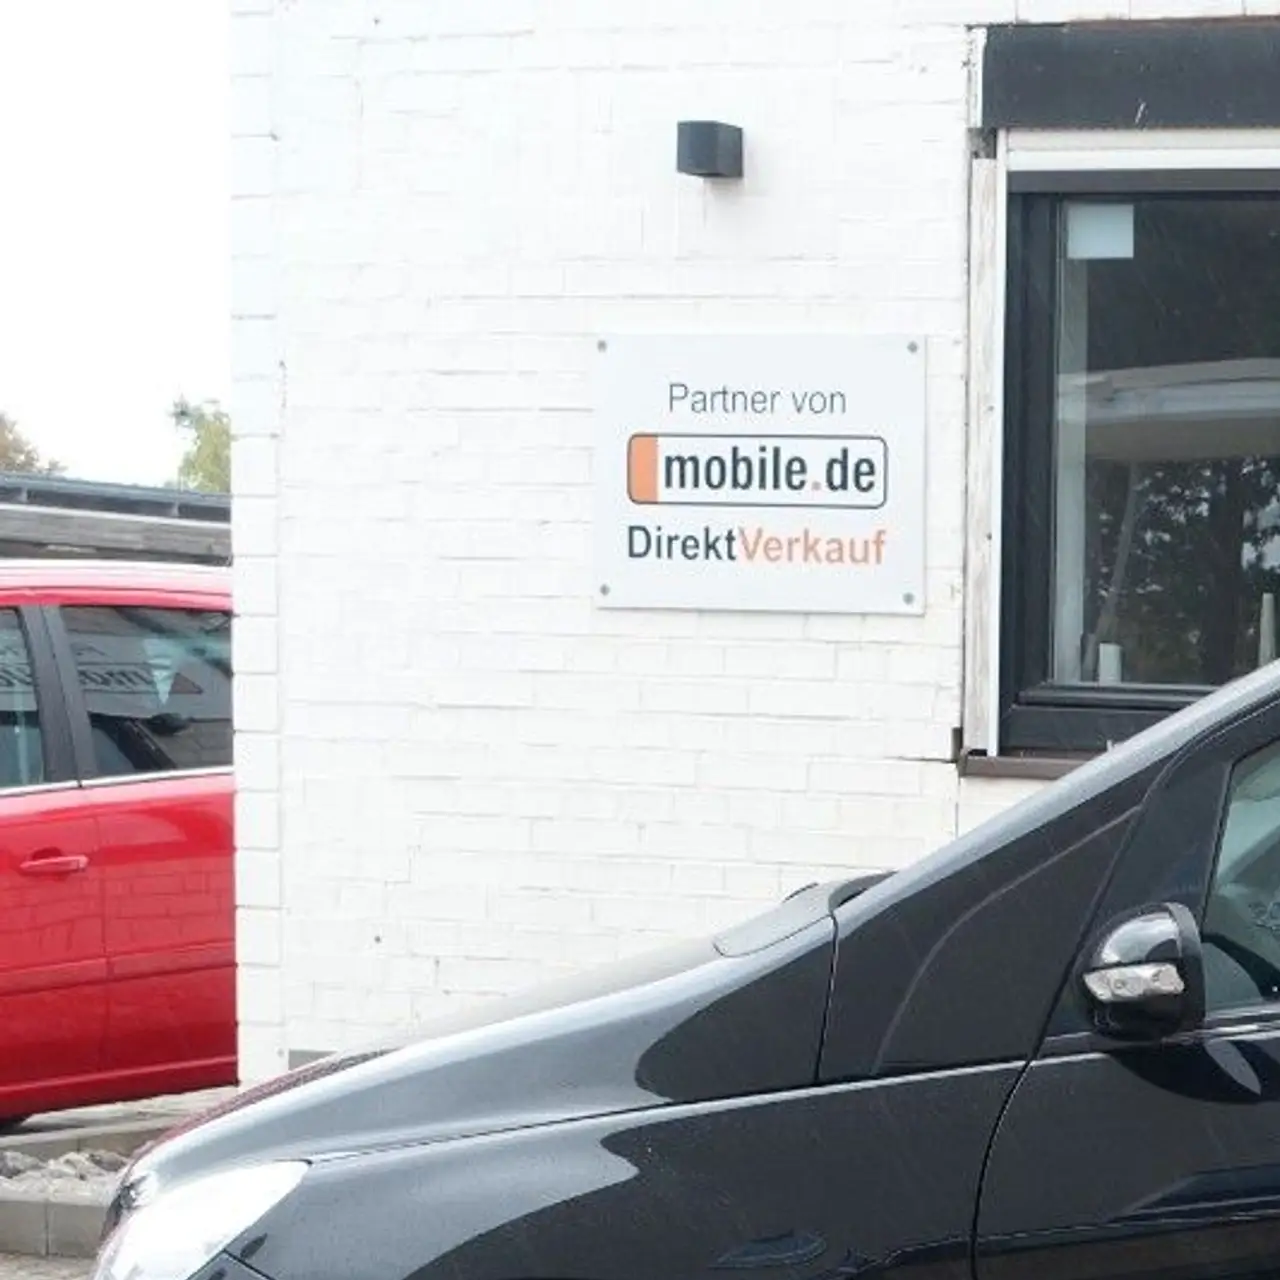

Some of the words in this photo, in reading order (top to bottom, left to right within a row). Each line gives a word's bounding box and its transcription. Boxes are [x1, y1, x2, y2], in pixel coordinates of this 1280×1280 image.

[668, 383, 781, 414] Partner
[791, 390, 847, 414] von
[664, 445, 877, 493] mobile.de
[626, 525, 886, 566] DirektVerkauf
